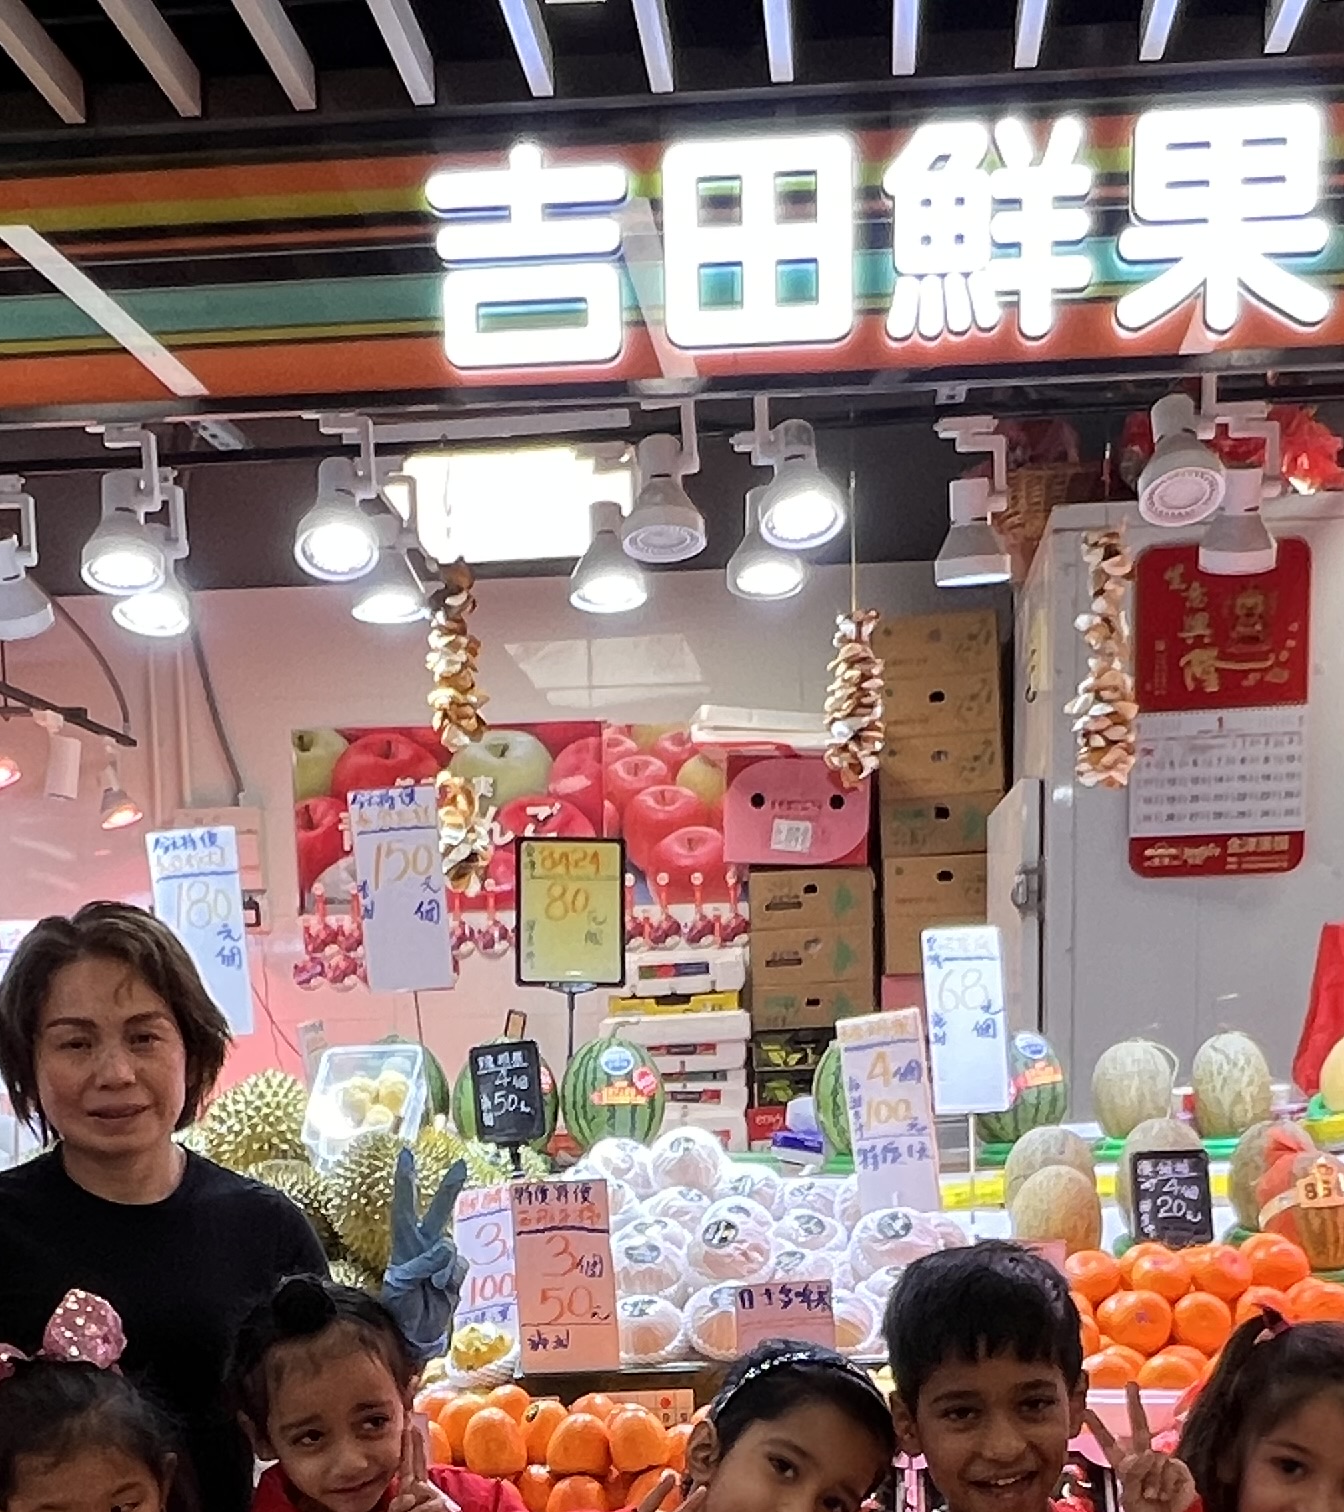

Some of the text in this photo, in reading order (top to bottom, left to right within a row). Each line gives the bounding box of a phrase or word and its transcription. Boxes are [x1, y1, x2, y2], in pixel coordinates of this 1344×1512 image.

[423, 100, 1332, 372] 吉田鮮果
[373, 839, 433, 891] 150
[176, 880, 233, 930] 180
[545, 881, 590, 922] 80
[937, 967, 989, 1014] 68
[865, 1098, 912, 1131] 100
[470, 1273, 518, 1307] 100
